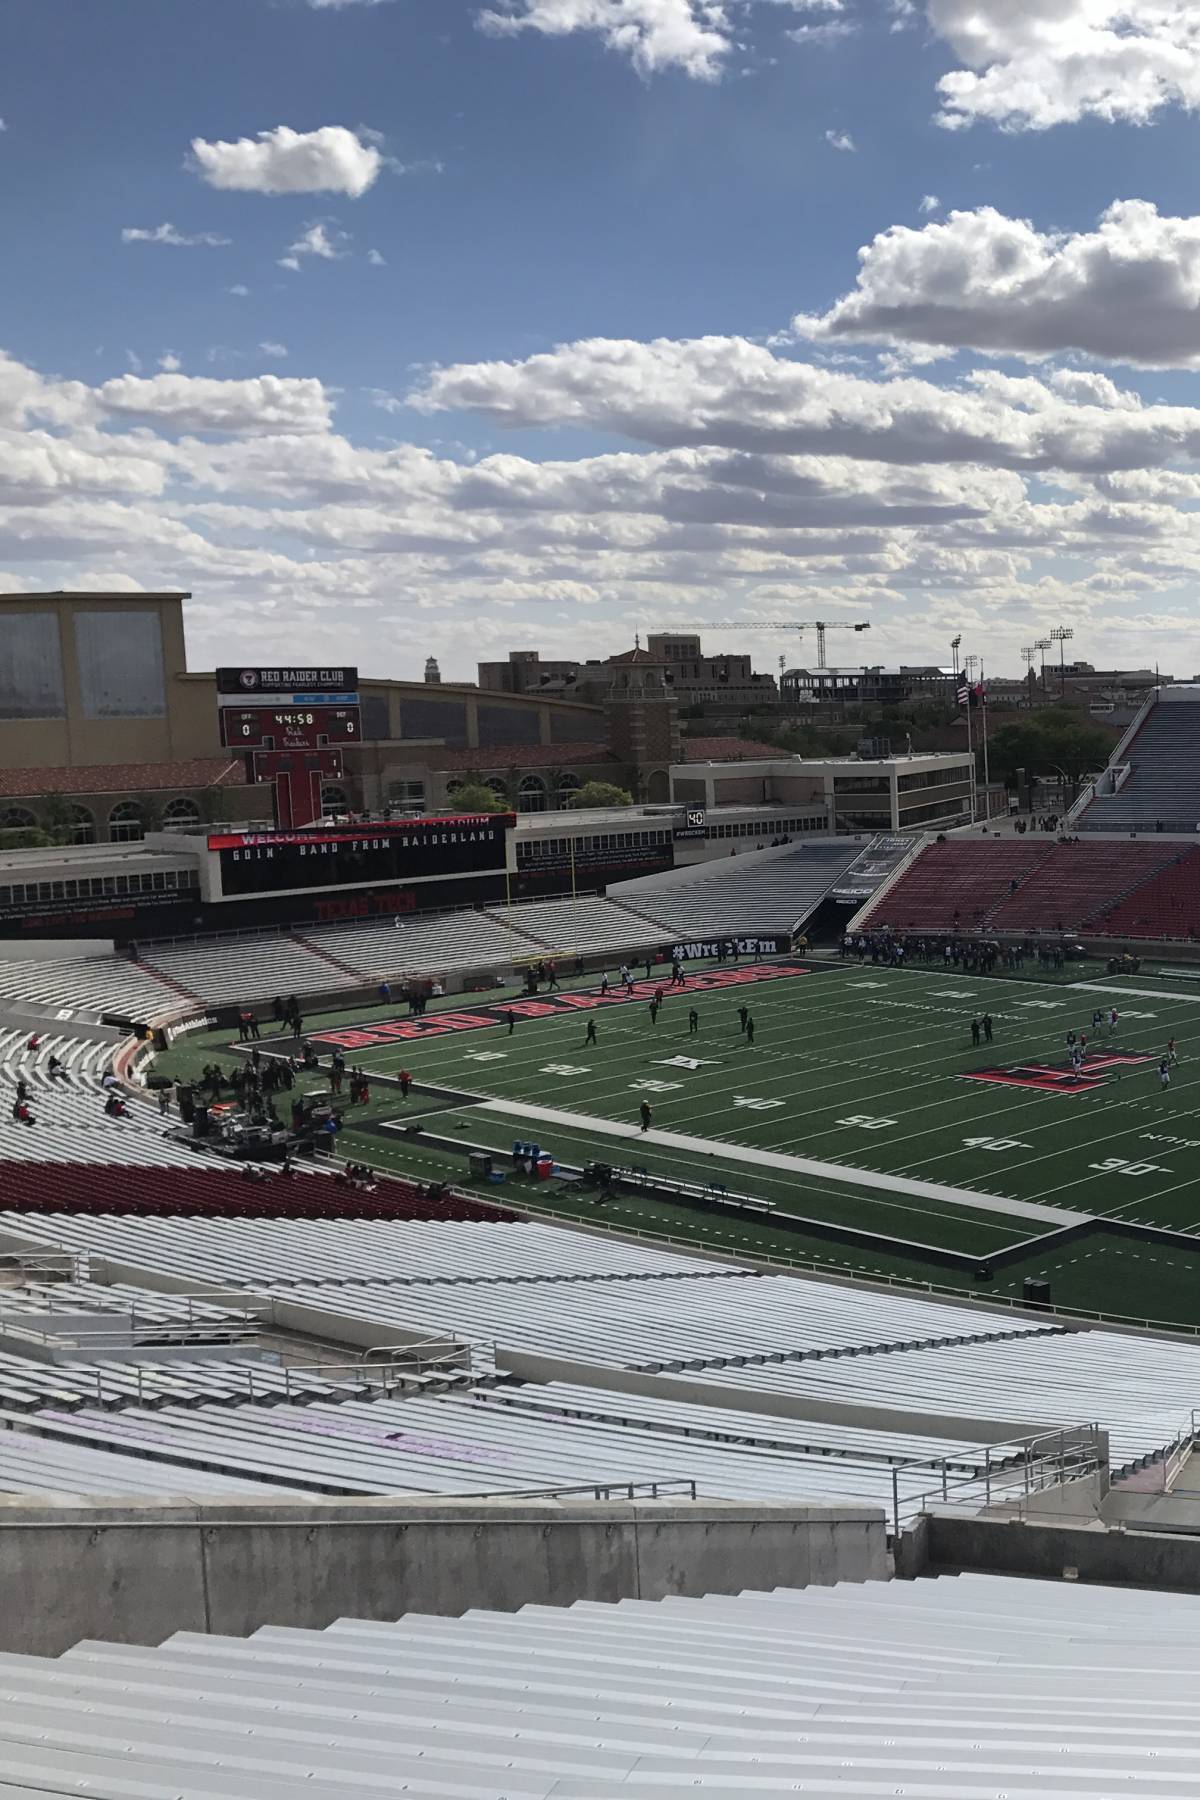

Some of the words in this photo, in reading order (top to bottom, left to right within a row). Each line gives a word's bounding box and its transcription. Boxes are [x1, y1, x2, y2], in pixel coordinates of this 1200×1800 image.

[261, 671, 280, 682] RED
[282, 671, 318, 682] RAIDER
[320, 671, 344, 682] CLUB
[275, 713, 314, 725] 44:58
[242, 724, 250, 736] 0
[347, 722, 354, 733] 0
[688, 812, 703, 825] 40
[233, 846, 283, 861] GOIN'
[300, 842, 338, 856] BAND
[352, 838, 391, 851] FROM
[402, 830, 495, 847] RAIDERLAND
[305, 1013, 502, 1049] RED
[488, 965, 812, 1018] RAIDERS
[835, 1115, 898, 1130] 50
[962, 1136, 1021, 1151] 40
[1088, 1158, 1160, 1177] 30
